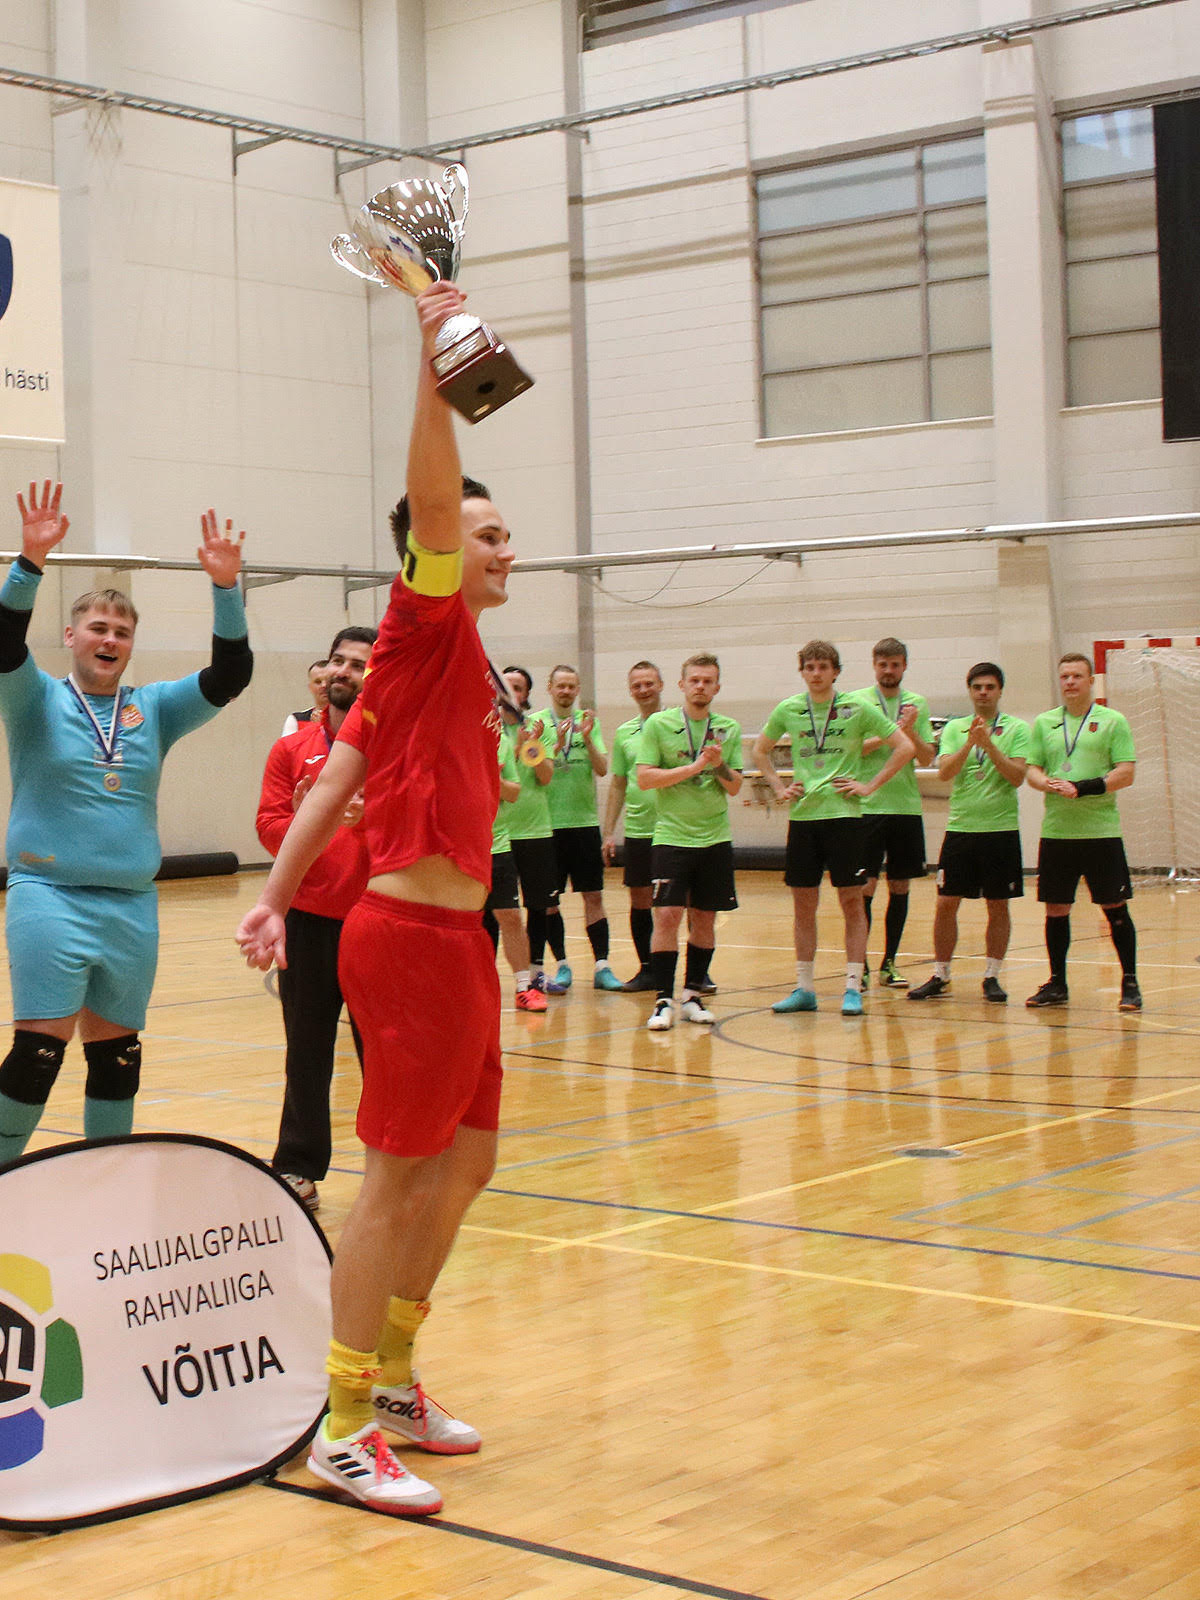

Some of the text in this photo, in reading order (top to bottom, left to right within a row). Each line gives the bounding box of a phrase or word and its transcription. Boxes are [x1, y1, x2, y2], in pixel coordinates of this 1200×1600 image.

[5, 368, 50, 392] hästi
[94, 1216, 284, 1281] SAALIJALGPALLI
[125, 1270, 274, 1328] RAHVALIIGA
[142, 1336, 285, 1405] VÕITJA
